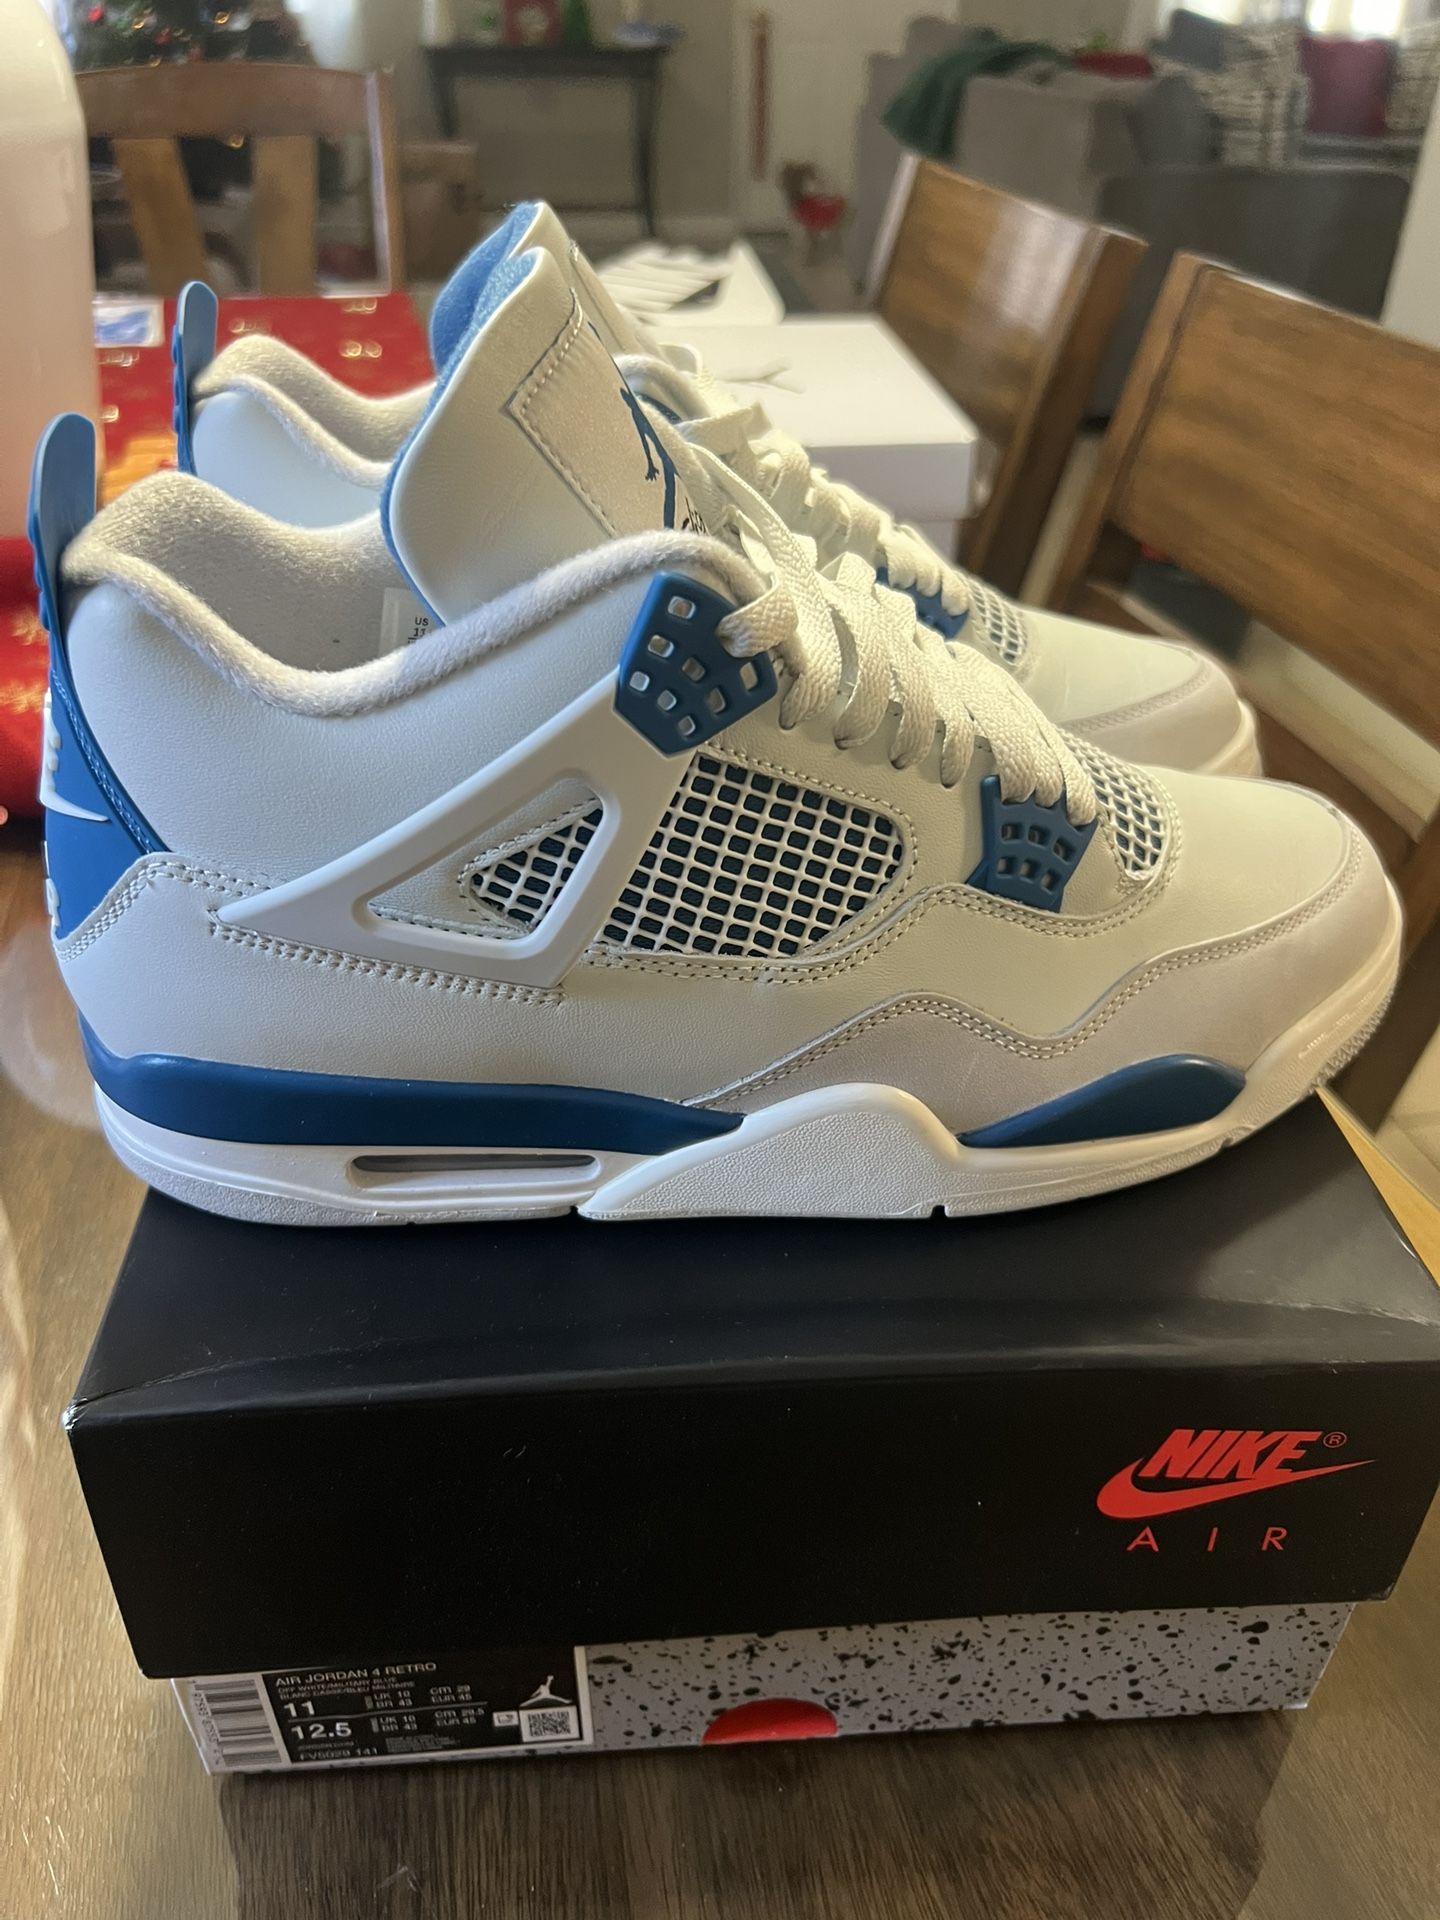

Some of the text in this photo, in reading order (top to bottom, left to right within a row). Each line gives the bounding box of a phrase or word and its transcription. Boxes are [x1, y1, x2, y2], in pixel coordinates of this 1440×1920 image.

[415, 617, 429, 626] US
[1137, 1428, 1323, 1479] NIKE
[1126, 1526, 1288, 1552] AIR
[275, 1662, 437, 1687] AIR JORDAN 4 RETRO
[374, 1693, 391, 1701] UK
[397, 1690, 410, 1698] 10
[456, 1684, 471, 1693] 29
[398, 1698, 413, 1706] 43
[431, 1694, 456, 1703] EUR
[283, 1700, 315, 1717] 11
[380, 1716, 398, 1724] UK
[291, 1722, 352, 1740] 12.5
